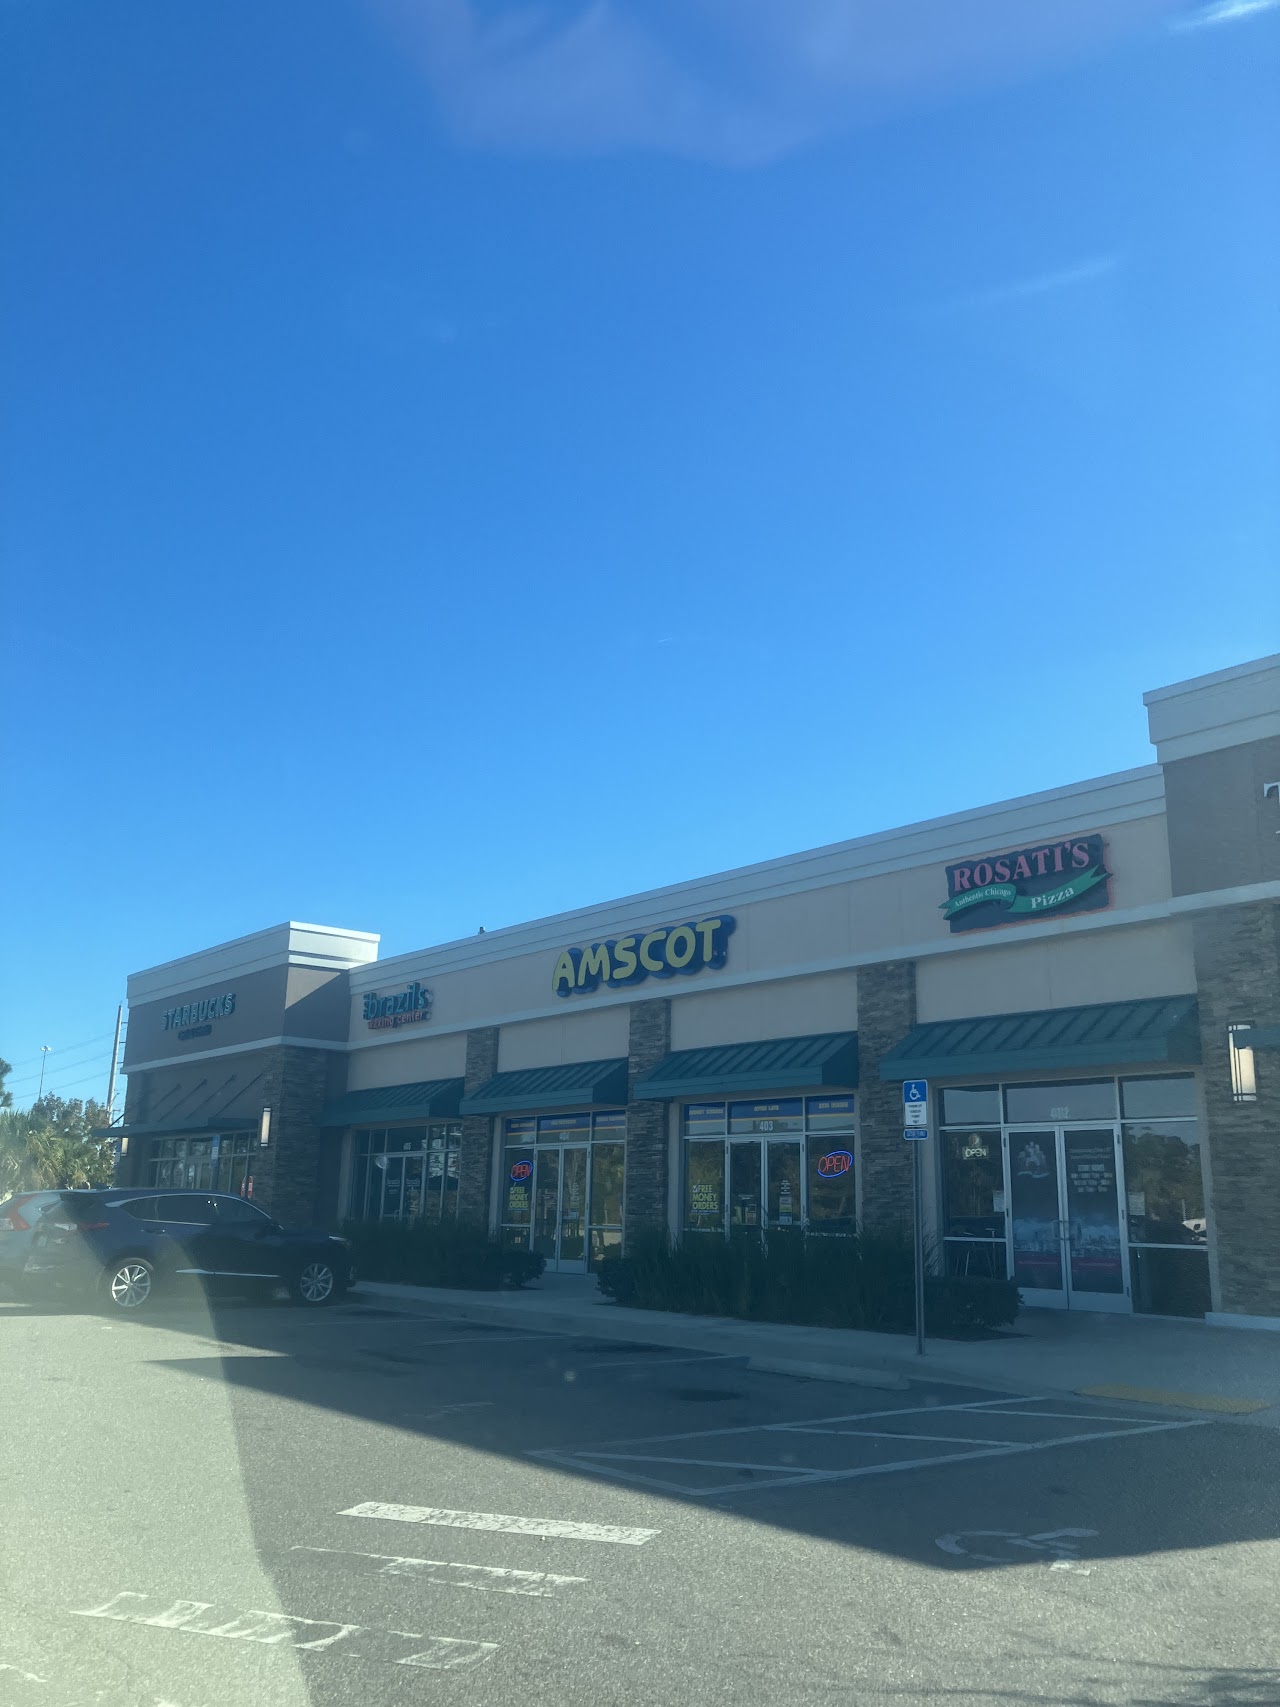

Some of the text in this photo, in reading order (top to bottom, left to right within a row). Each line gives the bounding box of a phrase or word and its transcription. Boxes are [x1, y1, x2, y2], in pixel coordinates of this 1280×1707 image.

[953, 841, 1090, 892] ROSATI'S
[953, 888, 1012, 908] Authentic Chicago
[1031, 887, 1075, 909] Pizza
[552, 919, 722, 991] AMSCOT
[161, 993, 234, 1030] STARBUCKS
[760, 1120, 774, 1131] 403
[965, 1148, 987, 1158] OPEN
[511, 1165, 531, 1178] OPEN
[818, 1155, 850, 1173] OPEN
[699, 1185, 713, 1193] FREE
[692, 1193, 718, 1201] MONEY
[692, 1201, 719, 1210] ORDERS
